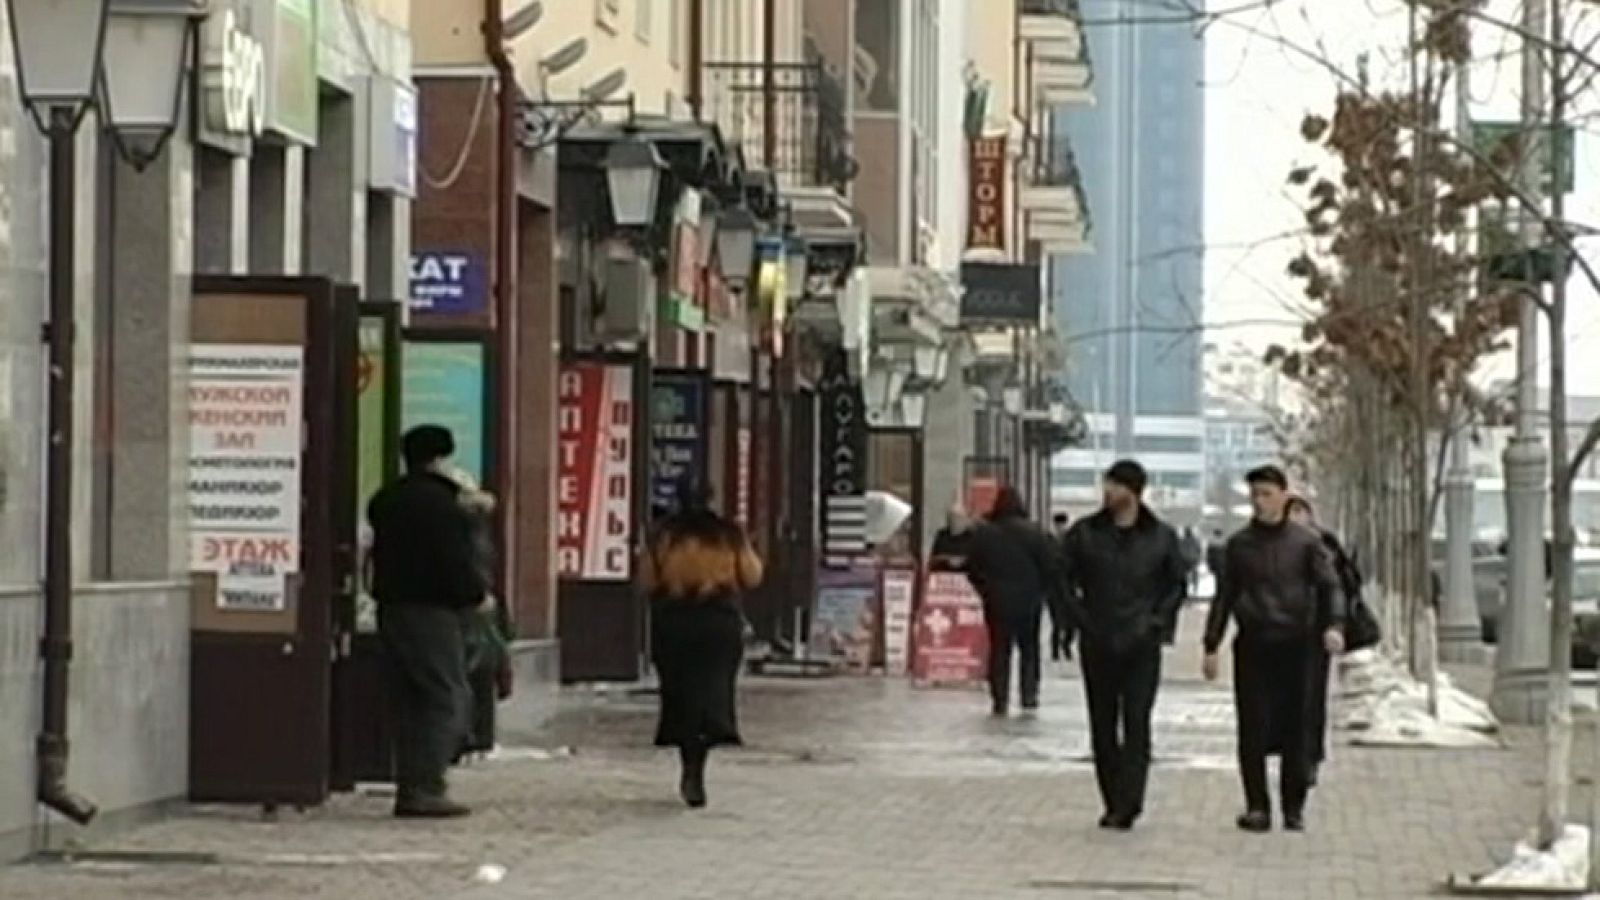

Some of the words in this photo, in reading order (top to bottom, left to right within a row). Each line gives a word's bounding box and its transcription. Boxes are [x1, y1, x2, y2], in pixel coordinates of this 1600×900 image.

[204, 538, 291, 562] ЭТАЖ
[558, 369, 583, 574] АПТЕКА
[605, 401, 631, 572] ПУЛЬС
